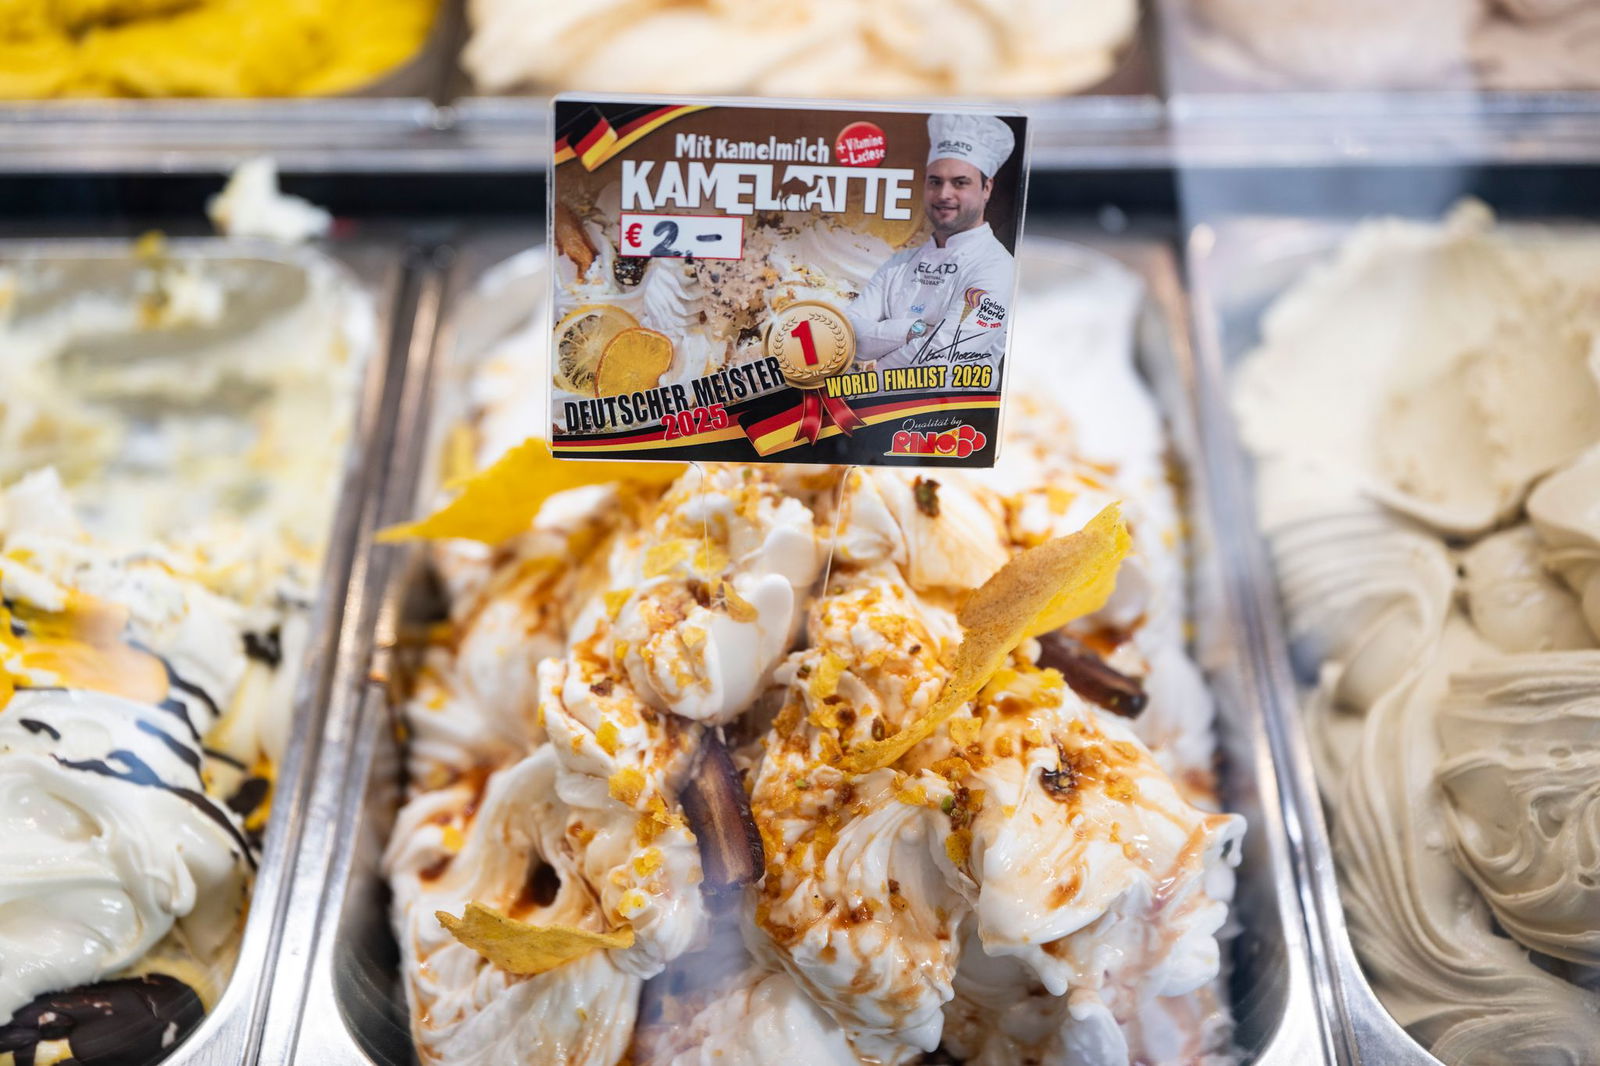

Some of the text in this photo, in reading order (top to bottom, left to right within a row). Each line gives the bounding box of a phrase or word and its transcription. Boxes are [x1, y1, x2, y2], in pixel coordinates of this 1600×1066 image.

[675, 133, 829, 163] Mit Kamelmilch
[845, 135, 883, 151] Vitamine
[849, 148, 885, 164] Lactose
[625, 223, 642, 248] €
[980, 303, 1005, 321] World
[983, 297, 1006, 313] Gelato
[791, 320, 818, 366] 1
[564, 355, 786, 432] DEUTSCHER MEISTER
[825, 365, 993, 398] WORLD FINALIST 2026
[661, 403, 730, 441] 2025
[950, 416, 963, 427] by
